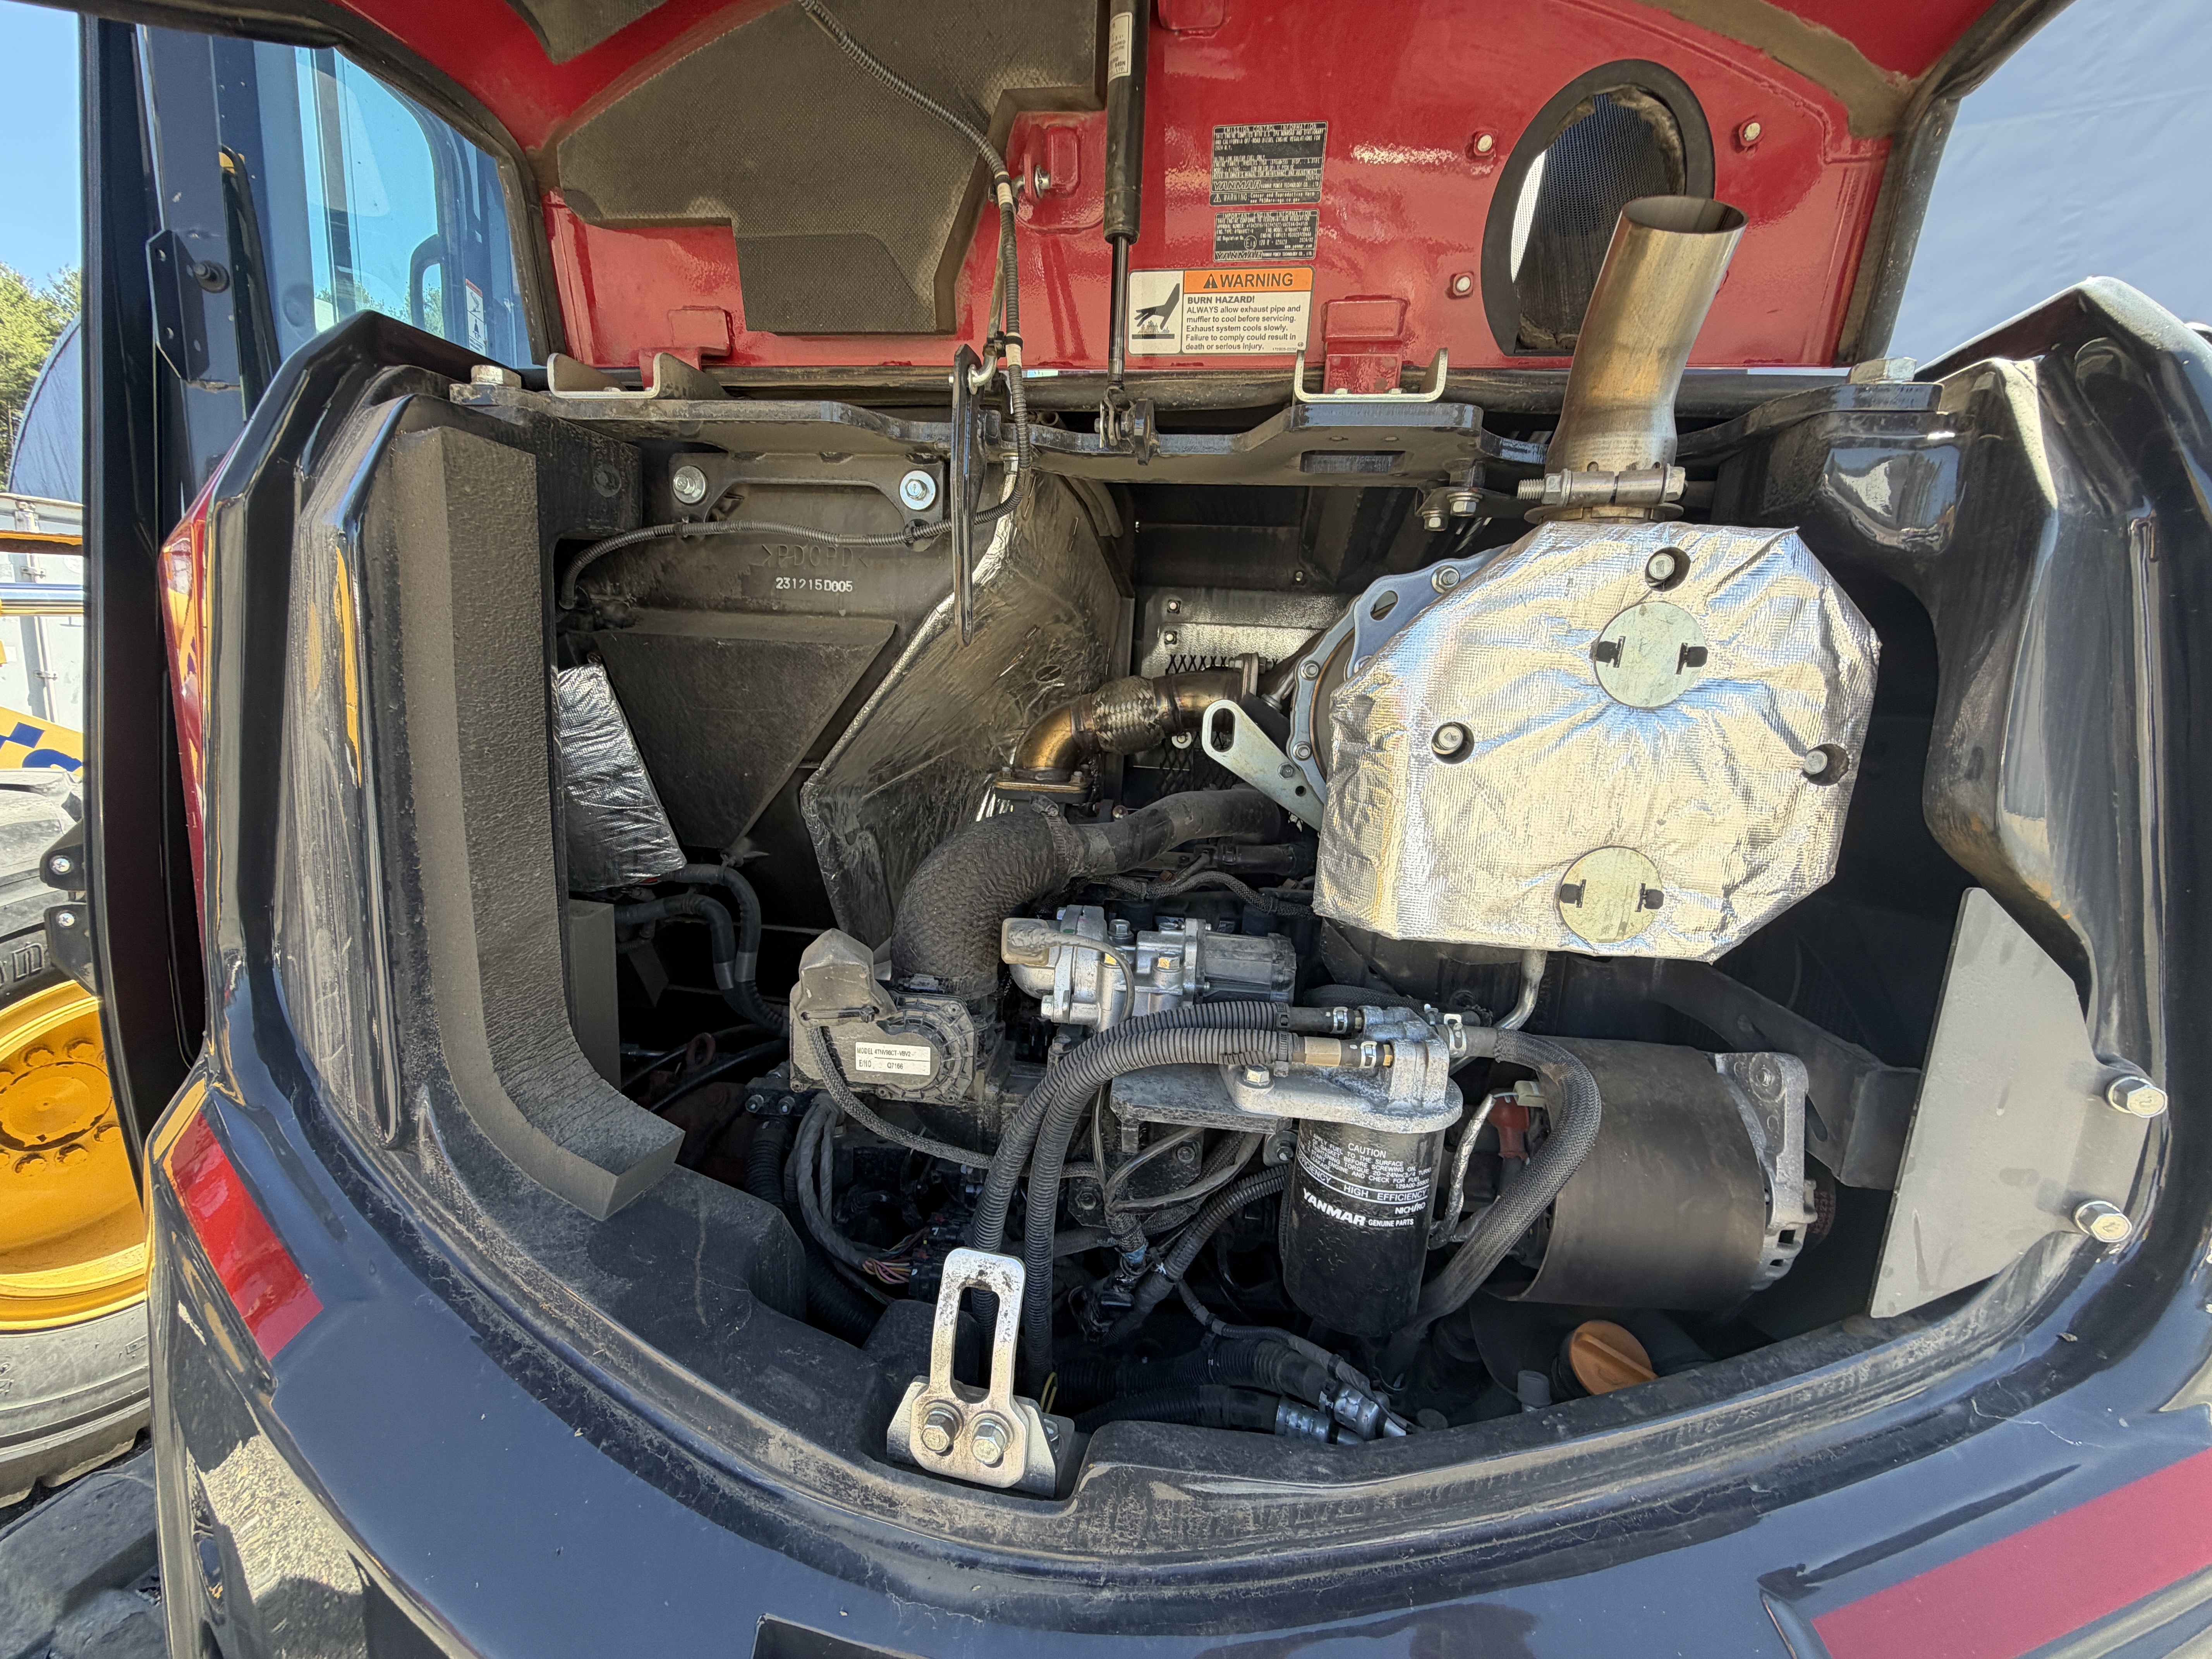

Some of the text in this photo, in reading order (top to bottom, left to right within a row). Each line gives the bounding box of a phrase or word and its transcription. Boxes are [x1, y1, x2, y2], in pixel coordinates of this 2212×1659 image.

[1213, 180, 1261, 191] YANMAR
[1216, 251, 1262, 260] YANMAR
[1220, 273, 1293, 287] WARNING
[1215, 295, 1255, 304] HAZARD!
[1270, 305, 1285, 314] pipe
[1262, 314, 1296, 323] servicing.
[1264, 324, 1288, 333] slowly.
[1219, 333, 1245, 342] comply
[1243, 342, 1264, 351] injury.
[776, 577, 853, 592] 231215D005
[1313, 1133, 1328, 1146] APPLY
[1329, 1144, 1343, 1155] FUEL
[1359, 1155, 1372, 1163] THE
[1348, 1143, 1386, 1158] CAUTION
[1313, 1144, 1340, 1164] TIGHTENING
[1344, 1162, 1370, 1174] TORQUE
[1321, 1144, 1341, 1158] GASKET
[1344, 1156, 1368, 1168] BEFORE
[1371, 1164, 1404, 1173] SCREWING
[1311, 1149, 1326, 1162] START
[1328, 1161, 1348, 1174] ENGINE
[1369, 1175, 1389, 1183] CHECK
[1343, 1184, 1369, 1198] HIGH
[1377, 1189, 1427, 1201] EFFICIENCY
[1304, 1187, 1366, 1226] YANMAR
[1396, 1218, 1414, 1226] PARTS
